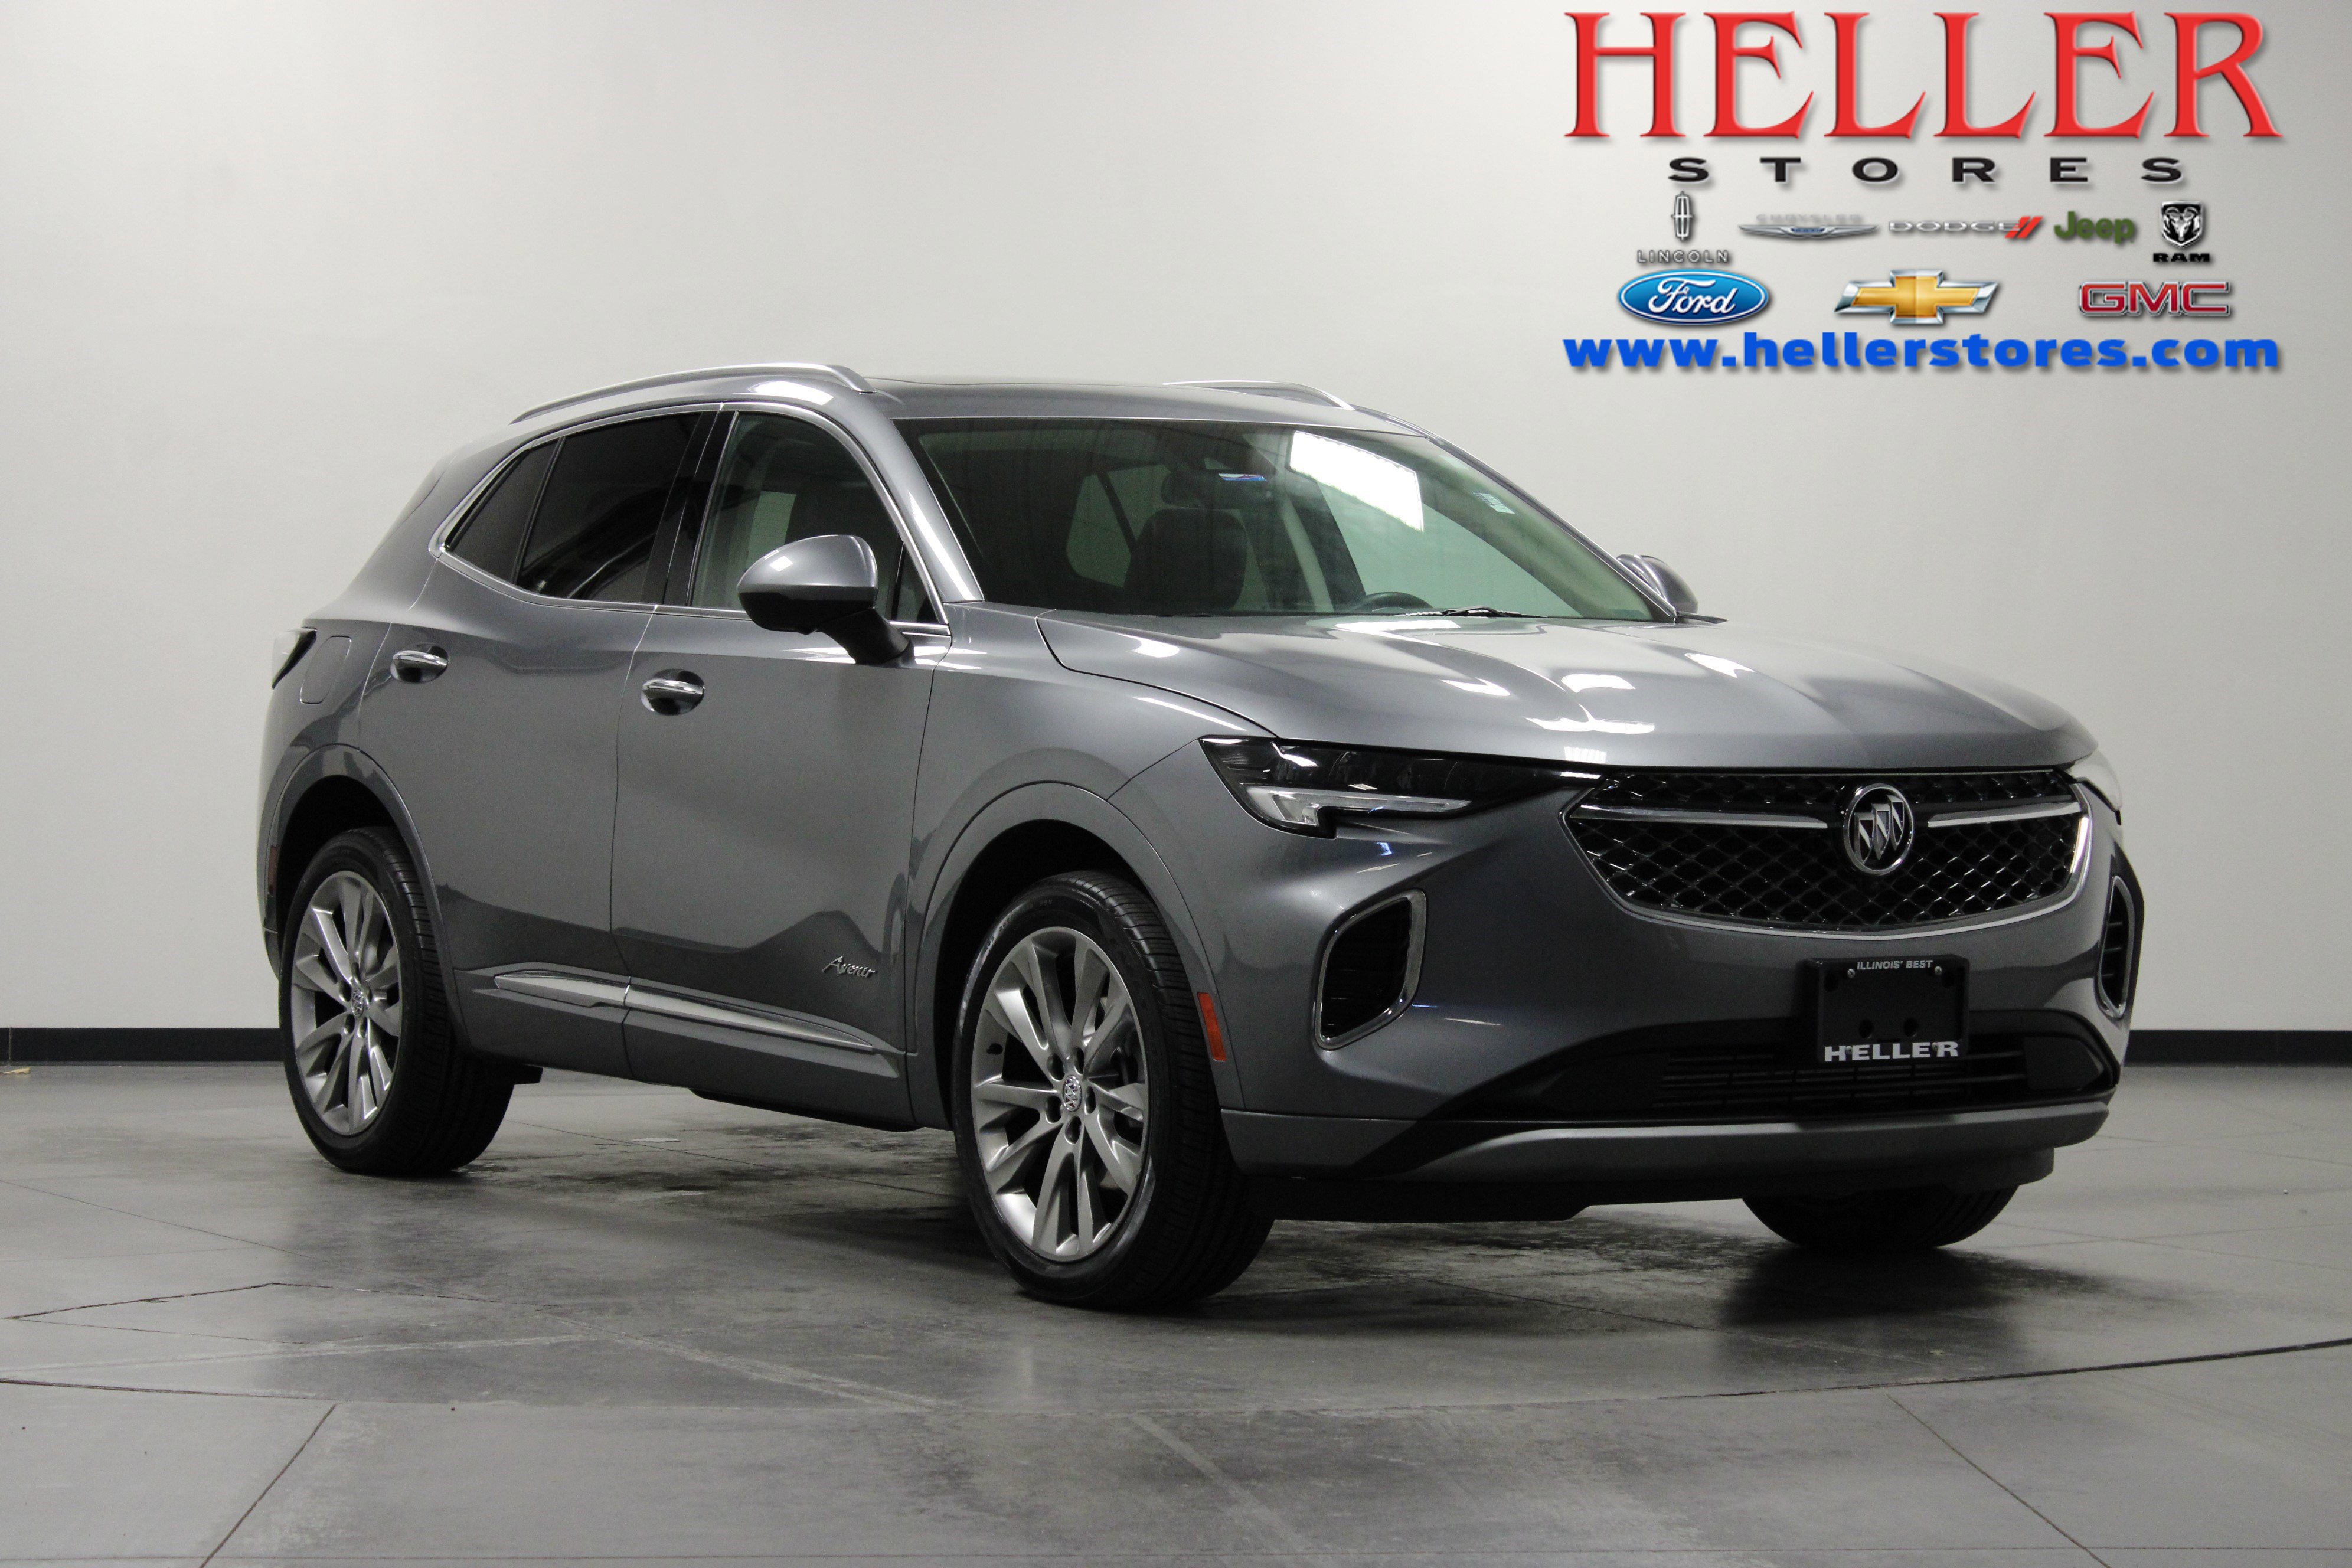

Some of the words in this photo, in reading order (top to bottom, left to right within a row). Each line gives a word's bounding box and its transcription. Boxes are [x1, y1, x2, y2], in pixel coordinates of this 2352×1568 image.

[1857, 961, 1903, 970] ILLINOIS'
[1906, 960, 1933, 968] BEST
[1824, 1041, 1959, 1062] HELLER
